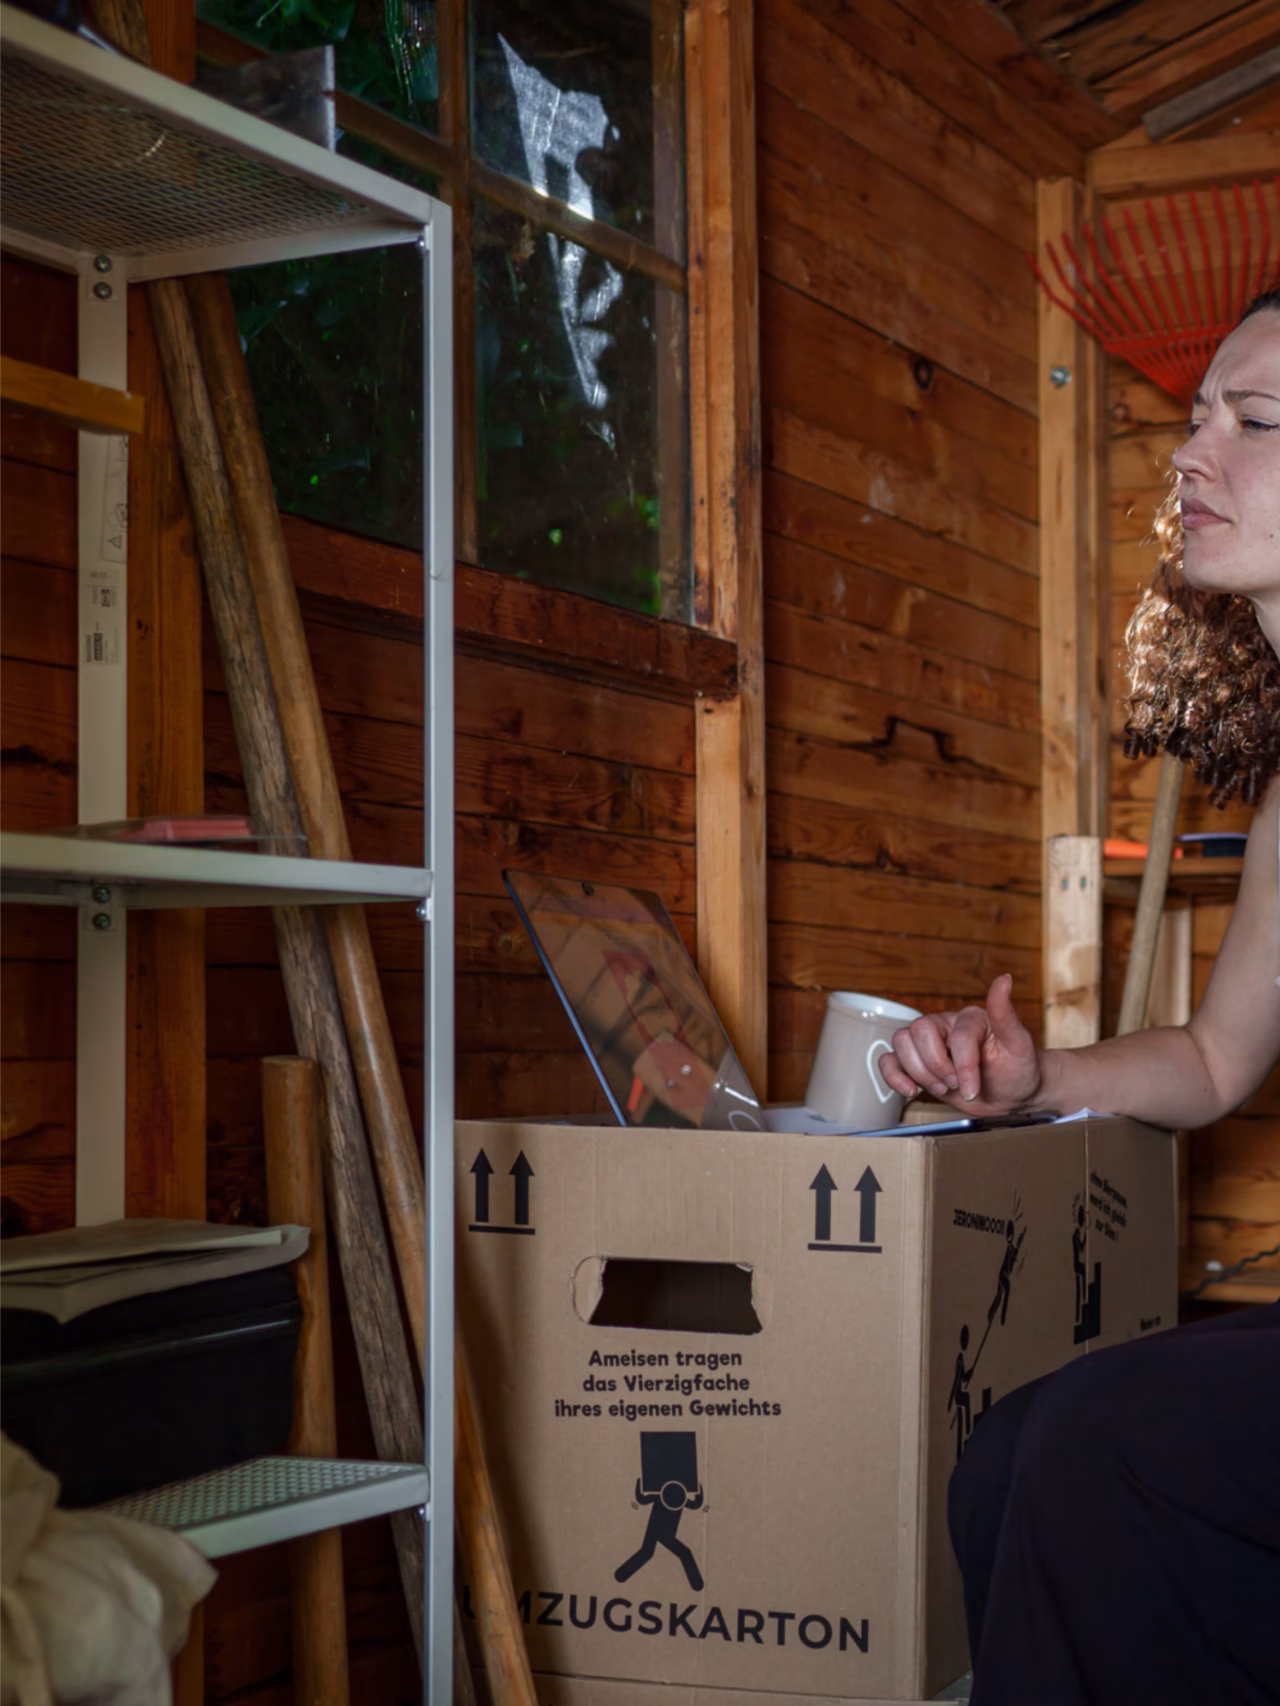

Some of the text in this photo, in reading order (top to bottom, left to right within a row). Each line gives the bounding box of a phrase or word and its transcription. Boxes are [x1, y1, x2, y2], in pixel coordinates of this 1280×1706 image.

[588, 1349, 742, 1371] Ameisen tragen
[583, 1373, 750, 1396] das Vierzigfache
[555, 1398, 782, 1421] ihres eigenen Gewichts
